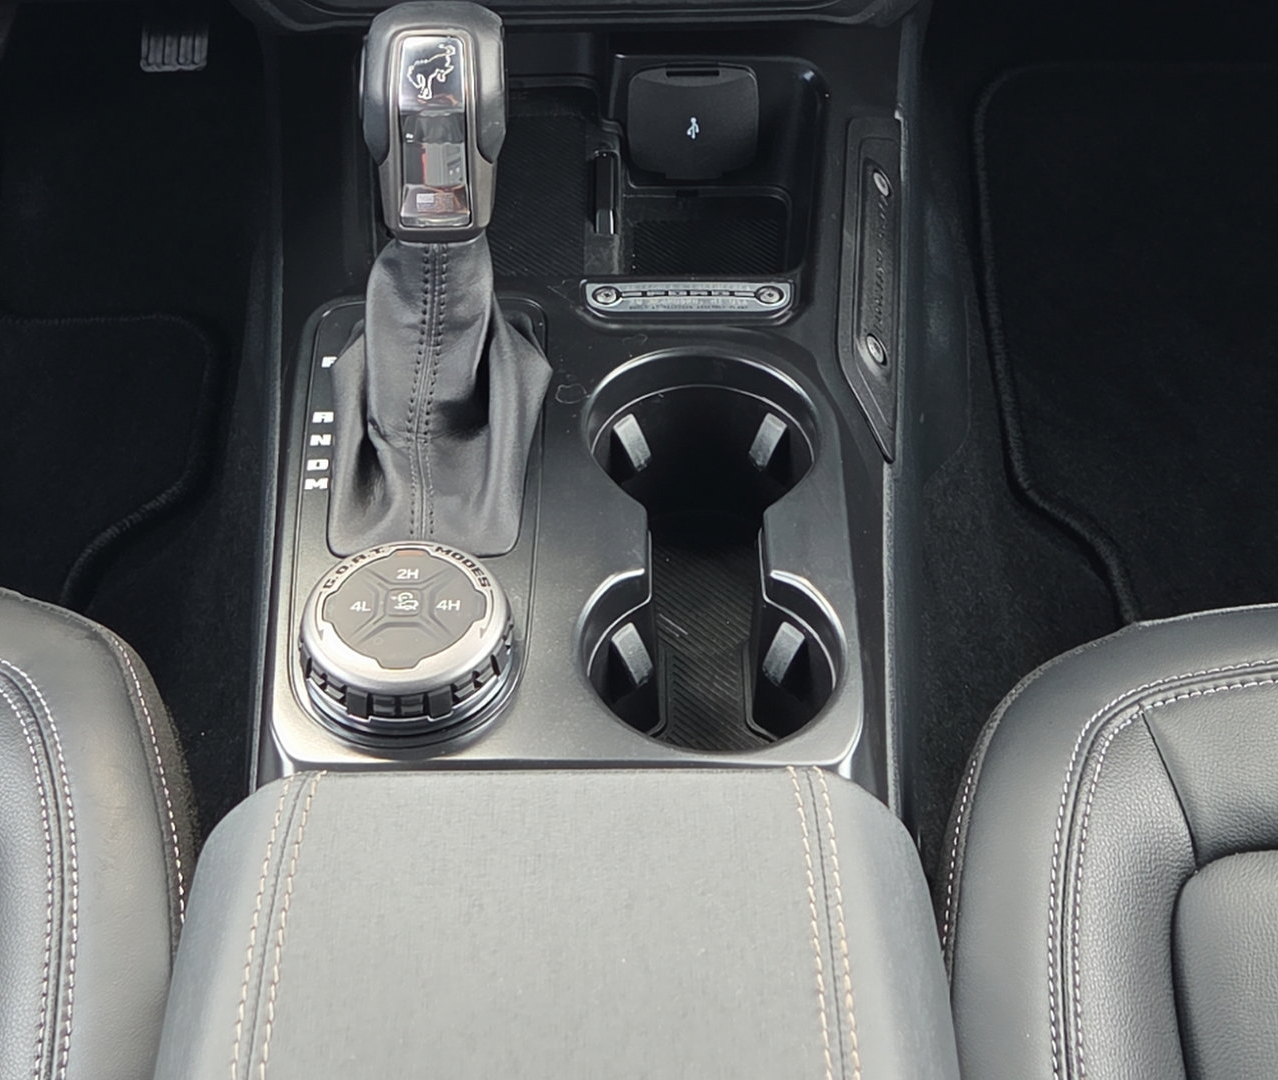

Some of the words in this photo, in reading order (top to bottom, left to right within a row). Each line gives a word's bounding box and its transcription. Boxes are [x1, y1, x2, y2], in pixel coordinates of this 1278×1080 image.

[309, 434, 332, 446] N
[306, 459, 329, 471] D
[304, 478, 329, 490] M
[435, 546, 491, 588] MODES
[396, 569, 419, 579] 2H
[350, 601, 371, 612] 4L
[436, 600, 461, 611] 4H
